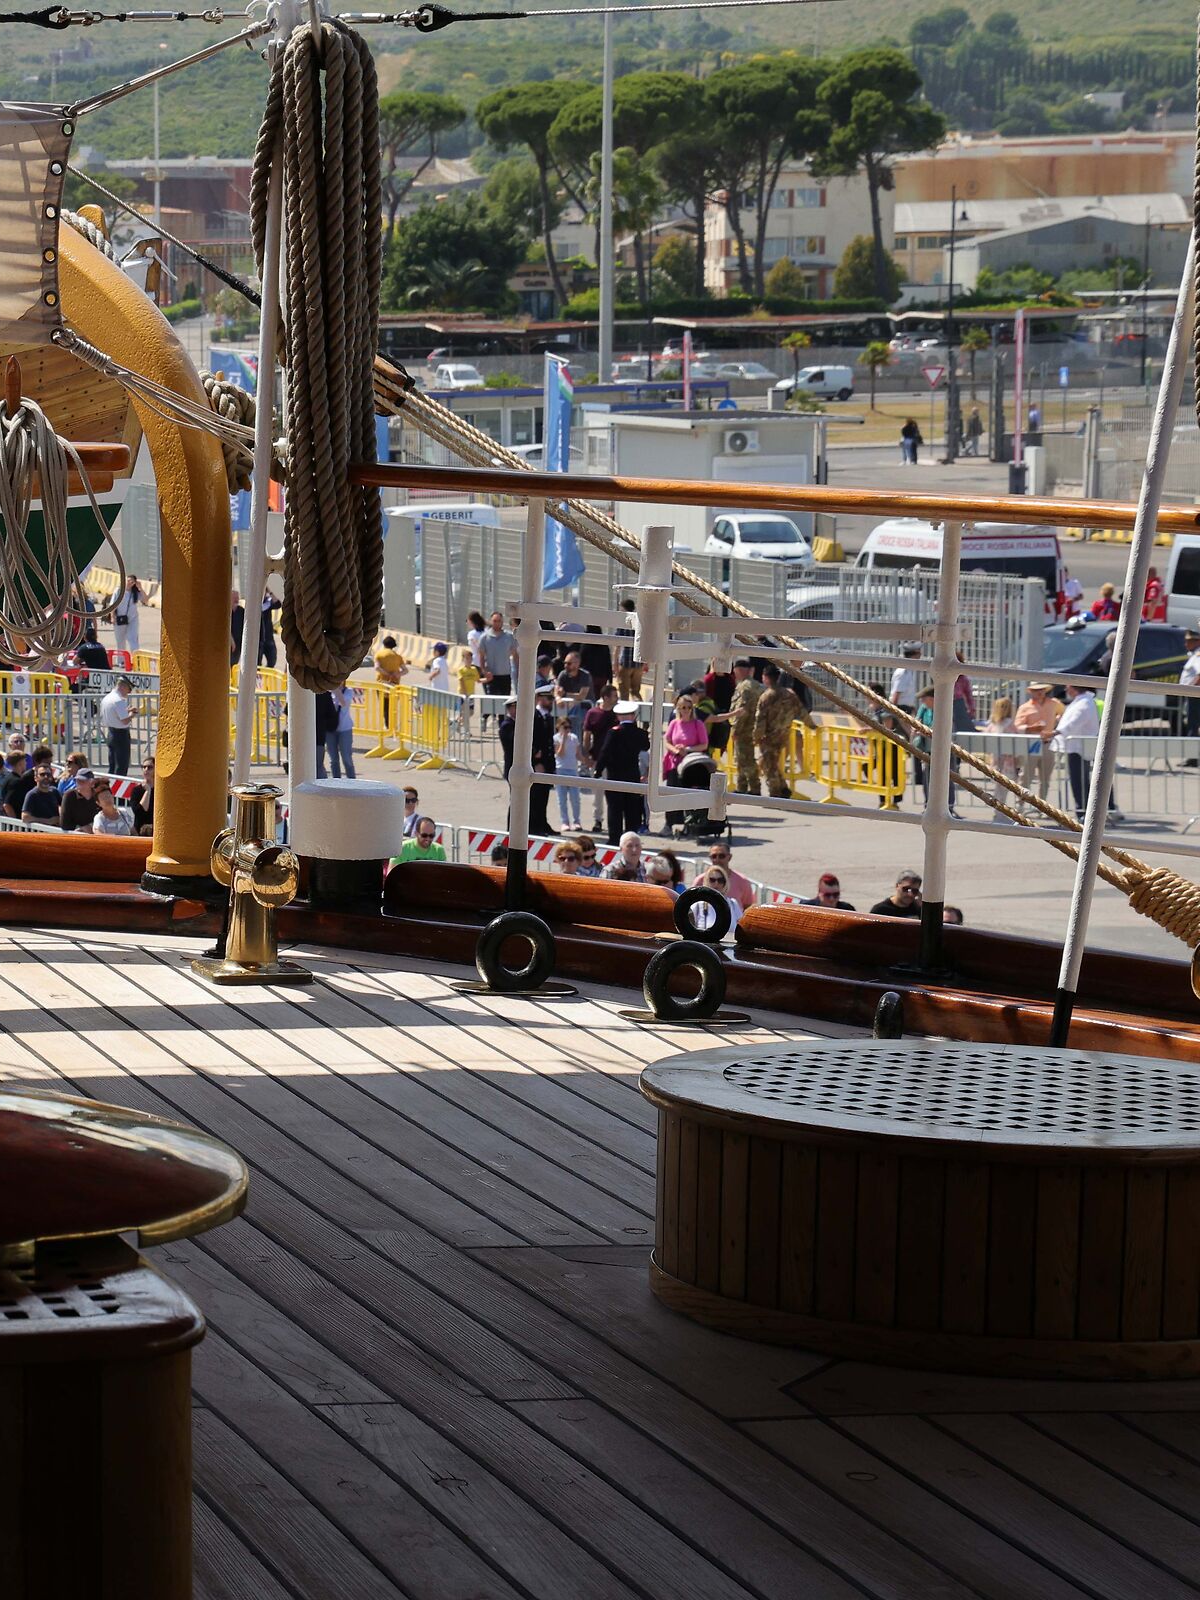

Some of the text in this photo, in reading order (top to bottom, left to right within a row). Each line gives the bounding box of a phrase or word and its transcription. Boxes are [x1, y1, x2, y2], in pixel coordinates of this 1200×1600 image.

[430, 511, 473, 520] GEBERIT
[960, 541, 1052, 551] ROCE ROSSA ITALIANA
